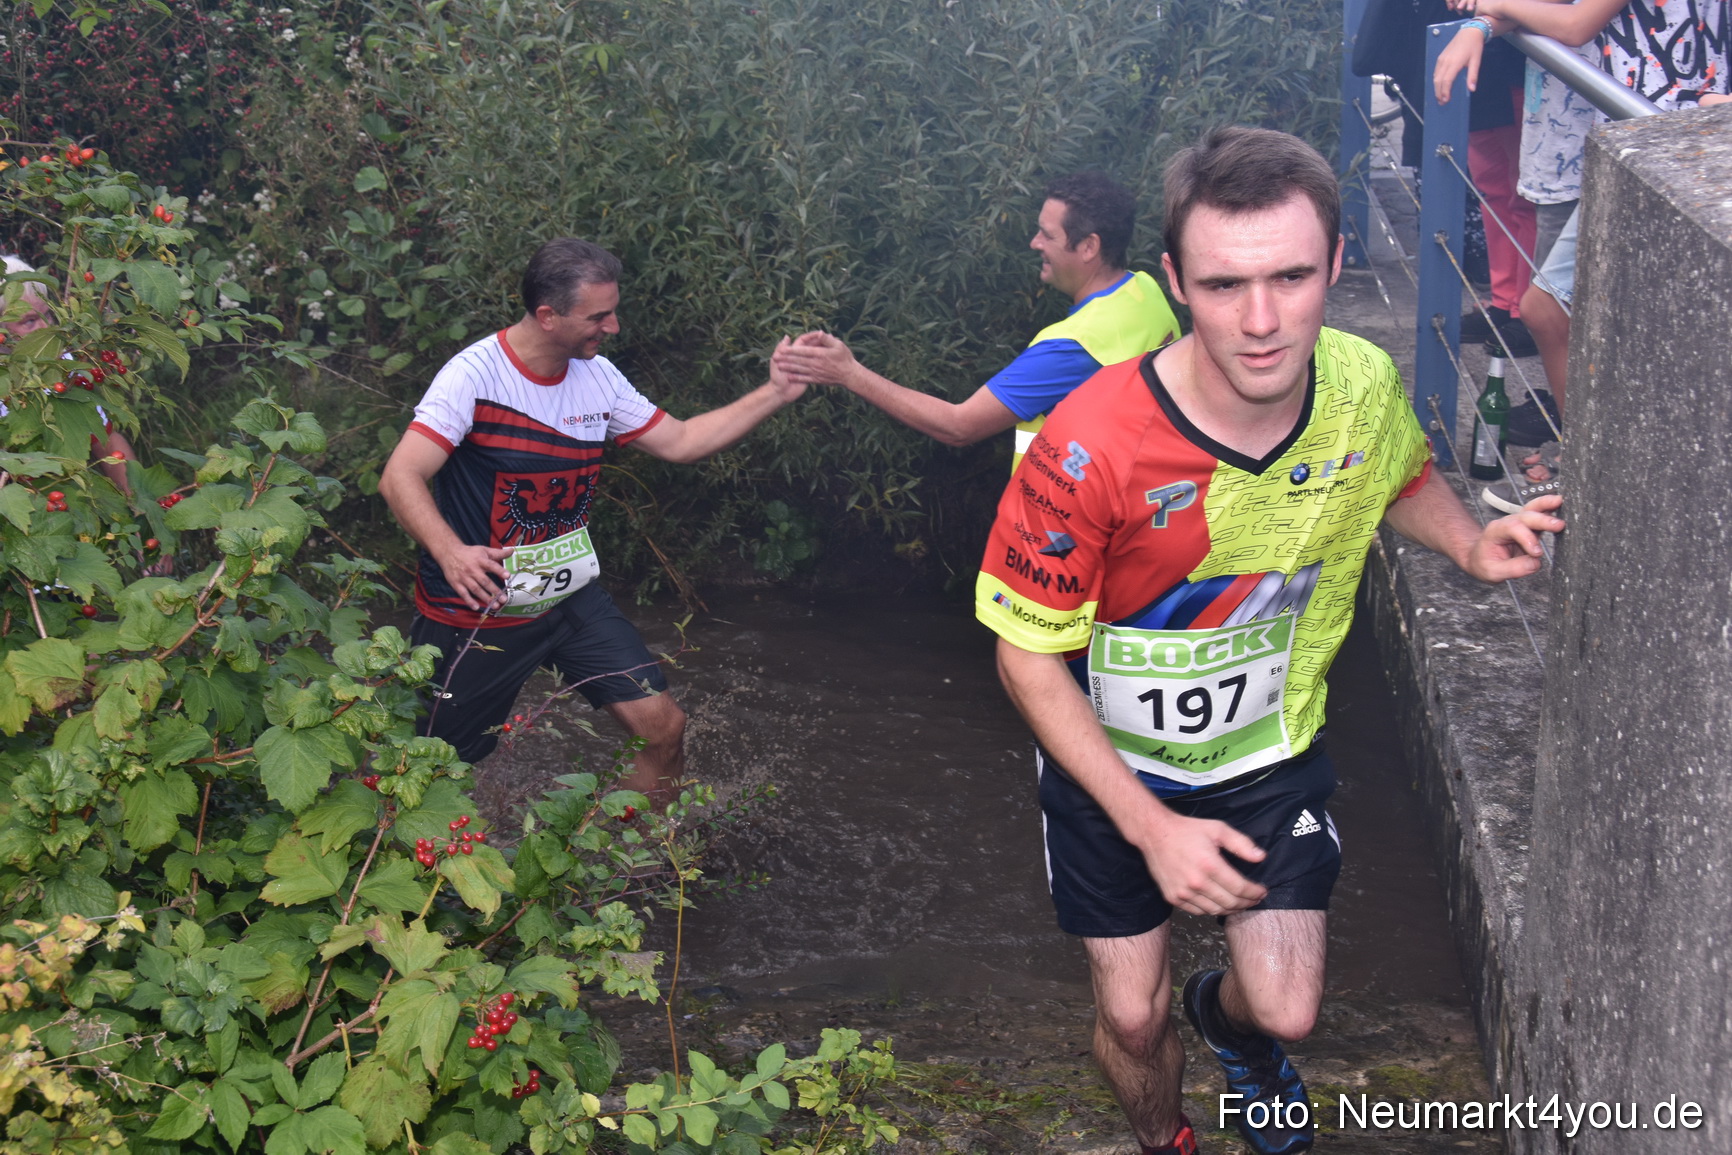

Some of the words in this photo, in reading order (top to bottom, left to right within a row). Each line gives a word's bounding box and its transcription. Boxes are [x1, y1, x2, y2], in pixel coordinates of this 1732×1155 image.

[514, 533, 588, 570] BOCK
[1005, 546, 1051, 589] BMW
[539, 568, 572, 597] 79
[1012, 603, 1089, 632] Motorsport
[1105, 622, 1276, 672] BOCK
[1270, 665, 1283, 676] E6
[1137, 672, 1248, 735] 197
[1150, 745, 1228, 766] Andreas
[1292, 824, 1321, 837] adidas
